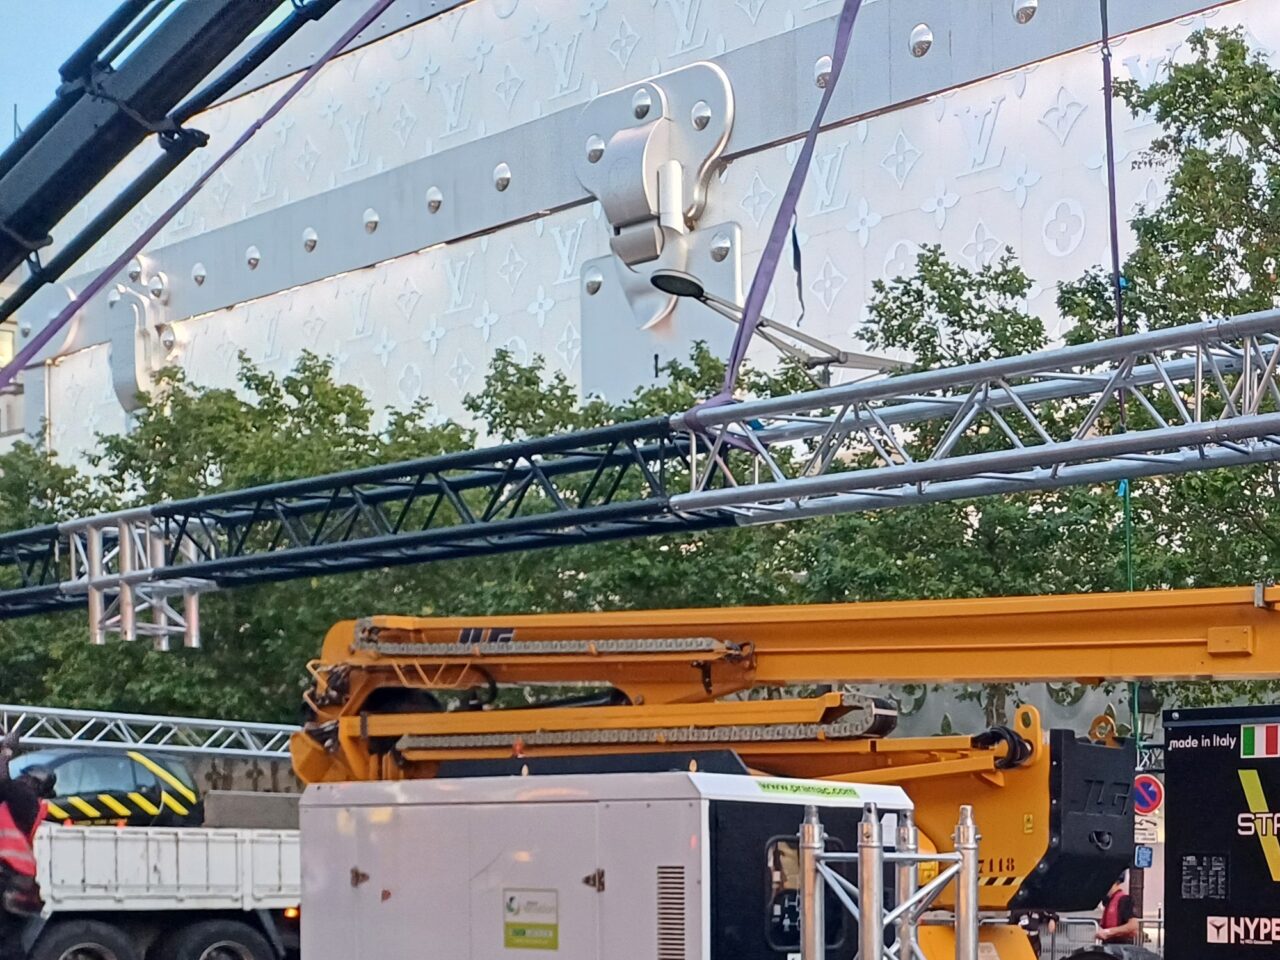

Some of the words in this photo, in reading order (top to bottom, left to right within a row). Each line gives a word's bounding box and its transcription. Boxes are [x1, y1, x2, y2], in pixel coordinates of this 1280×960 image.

[1170, 735, 1199, 749] made
[1201, 734, 1211, 747] in
[1212, 733, 1237, 749] Italy
